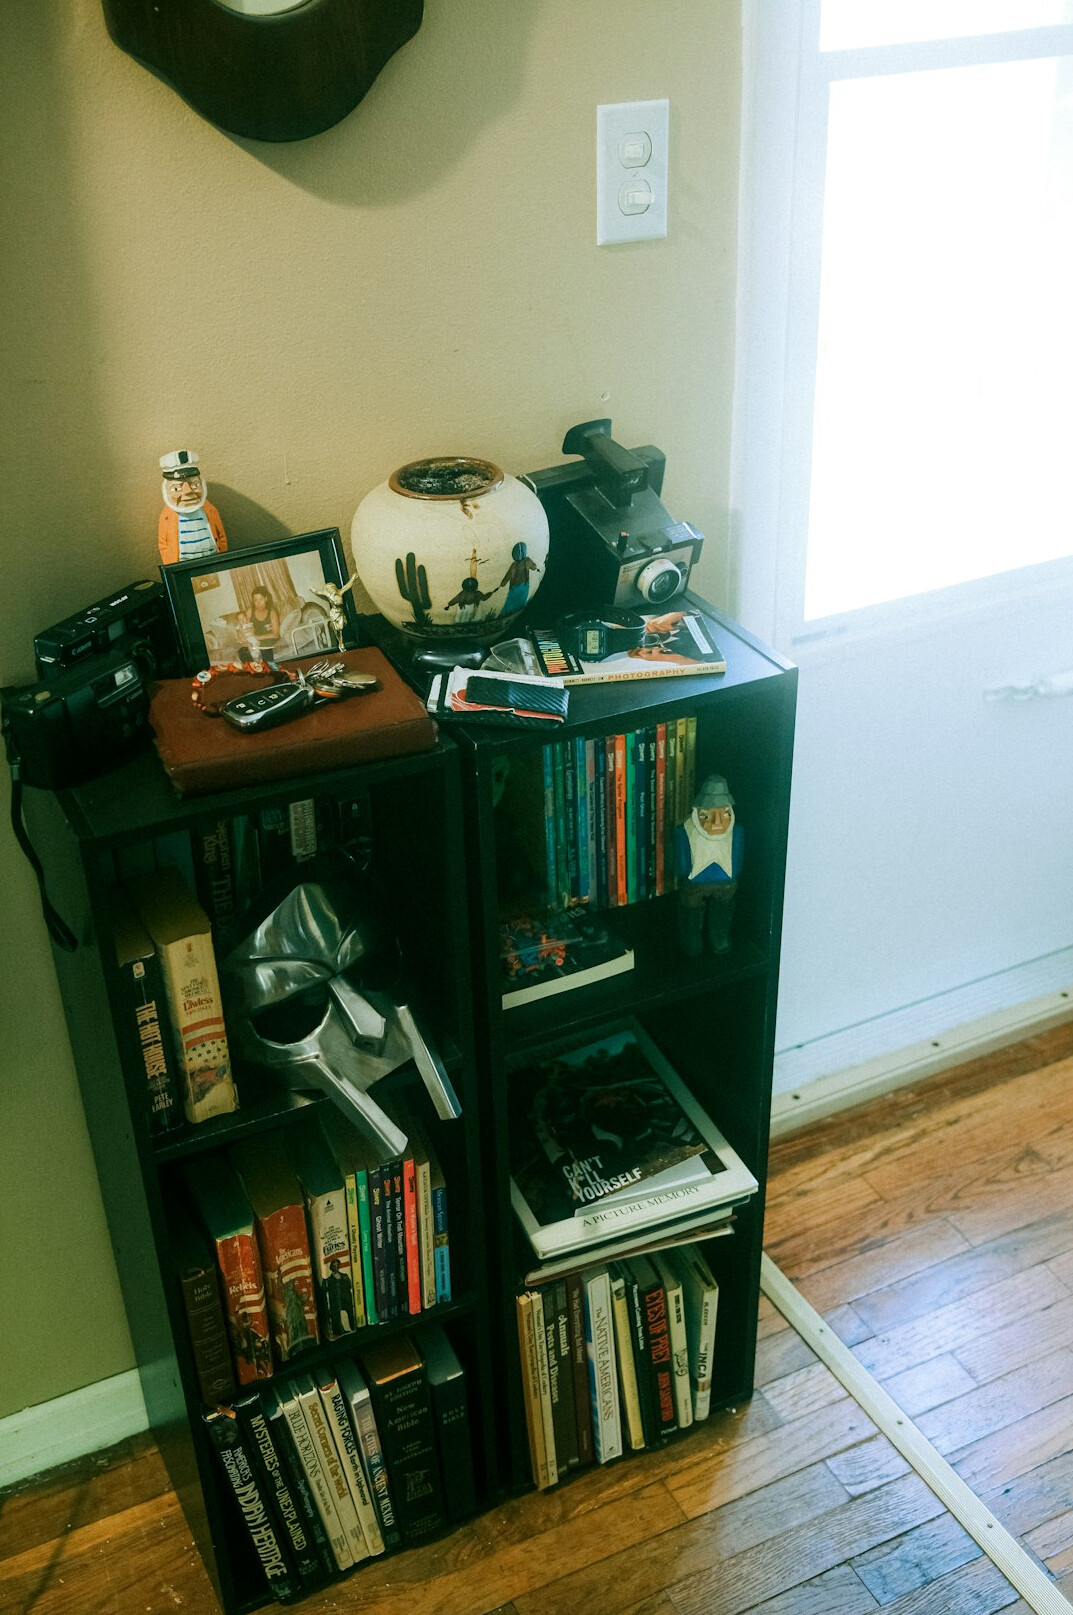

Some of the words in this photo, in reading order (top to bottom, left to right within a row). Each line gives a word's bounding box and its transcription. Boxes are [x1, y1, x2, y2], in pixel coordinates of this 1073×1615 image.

[72, 641, 92, 655] Canon
[607, 664, 686, 683] PHOTOGRAPHY
[202, 833, 218, 865] King
[135, 1001, 158, 1025] THE
[138, 1021, 161, 1046] HOT
[142, 1042, 167, 1080] HOUSE
[154, 1092, 169, 1105] PETE
[562, 1155, 603, 1179] CAN'T
[576, 1167, 643, 1203] YOURSELF
[394, 1196, 402, 1211] Terror
[435, 1188, 443, 1211] Mexican
[582, 1219, 593, 1227] A
[591, 1203, 646, 1224] PICTURE
[647, 1186, 701, 1208] MEMORY
[374, 1215, 383, 1232] Ghost
[395, 1211, 402, 1220] On
[395, 1220, 403, 1232] Troll
[435, 1210, 445, 1231] Spanish
[375, 1232, 383, 1249] Writer
[396, 1231, 404, 1255] Mountain
[228, 1279, 258, 1295] Rebels
[595, 1307, 603, 1319] The
[644, 1287, 666, 1323] EYES
[546, 1323, 555, 1349] Pests
[557, 1313, 570, 1357] Annuals
[595, 1316, 606, 1359] NATIVE
[647, 1319, 667, 1335] OF
[548, 1349, 557, 1367] and
[649, 1333, 671, 1364] PREY
[695, 1351, 708, 1379] INCA
[550, 1367, 560, 1404] Diseases
[598, 1357, 615, 1422] AMERICANS
[387, 1407, 428, 1428] American
[396, 1402, 416, 1414] New
[361, 1417, 373, 1435] THE
[397, 1419, 420, 1432] Bible
[251, 1414, 280, 1472] MYSTERIES
[288, 1410, 303, 1435] BLUE
[297, 1432, 321, 1478] HORIZONS
[308, 1402, 323, 1430] Secret
[317, 1425, 333, 1461] Corners
[328, 1463, 340, 1480] the
[334, 1475, 348, 1502] World
[331, 1393, 345, 1429] RAGING
[340, 1423, 356, 1455] FORCES
[349, 1453, 358, 1472] Earth
[355, 1477, 370, 1507] Upheaval
[364, 1433, 379, 1459] CITIES
[220, 1449, 243, 1489] FASCINATING
[233, 1446, 252, 1482] AMERICA'S
[369, 1455, 380, 1467] OF
[271, 1470, 281, 1478] OF
[275, 1477, 284, 1489] THE
[371, 1466, 389, 1500] ANCIENT
[235, 1481, 268, 1526] INDIAN
[379, 1496, 396, 1528] MEXICO
[275, 1486, 308, 1550] UNEXPLAINED
[251, 1522, 288, 1579] HERITAGE
